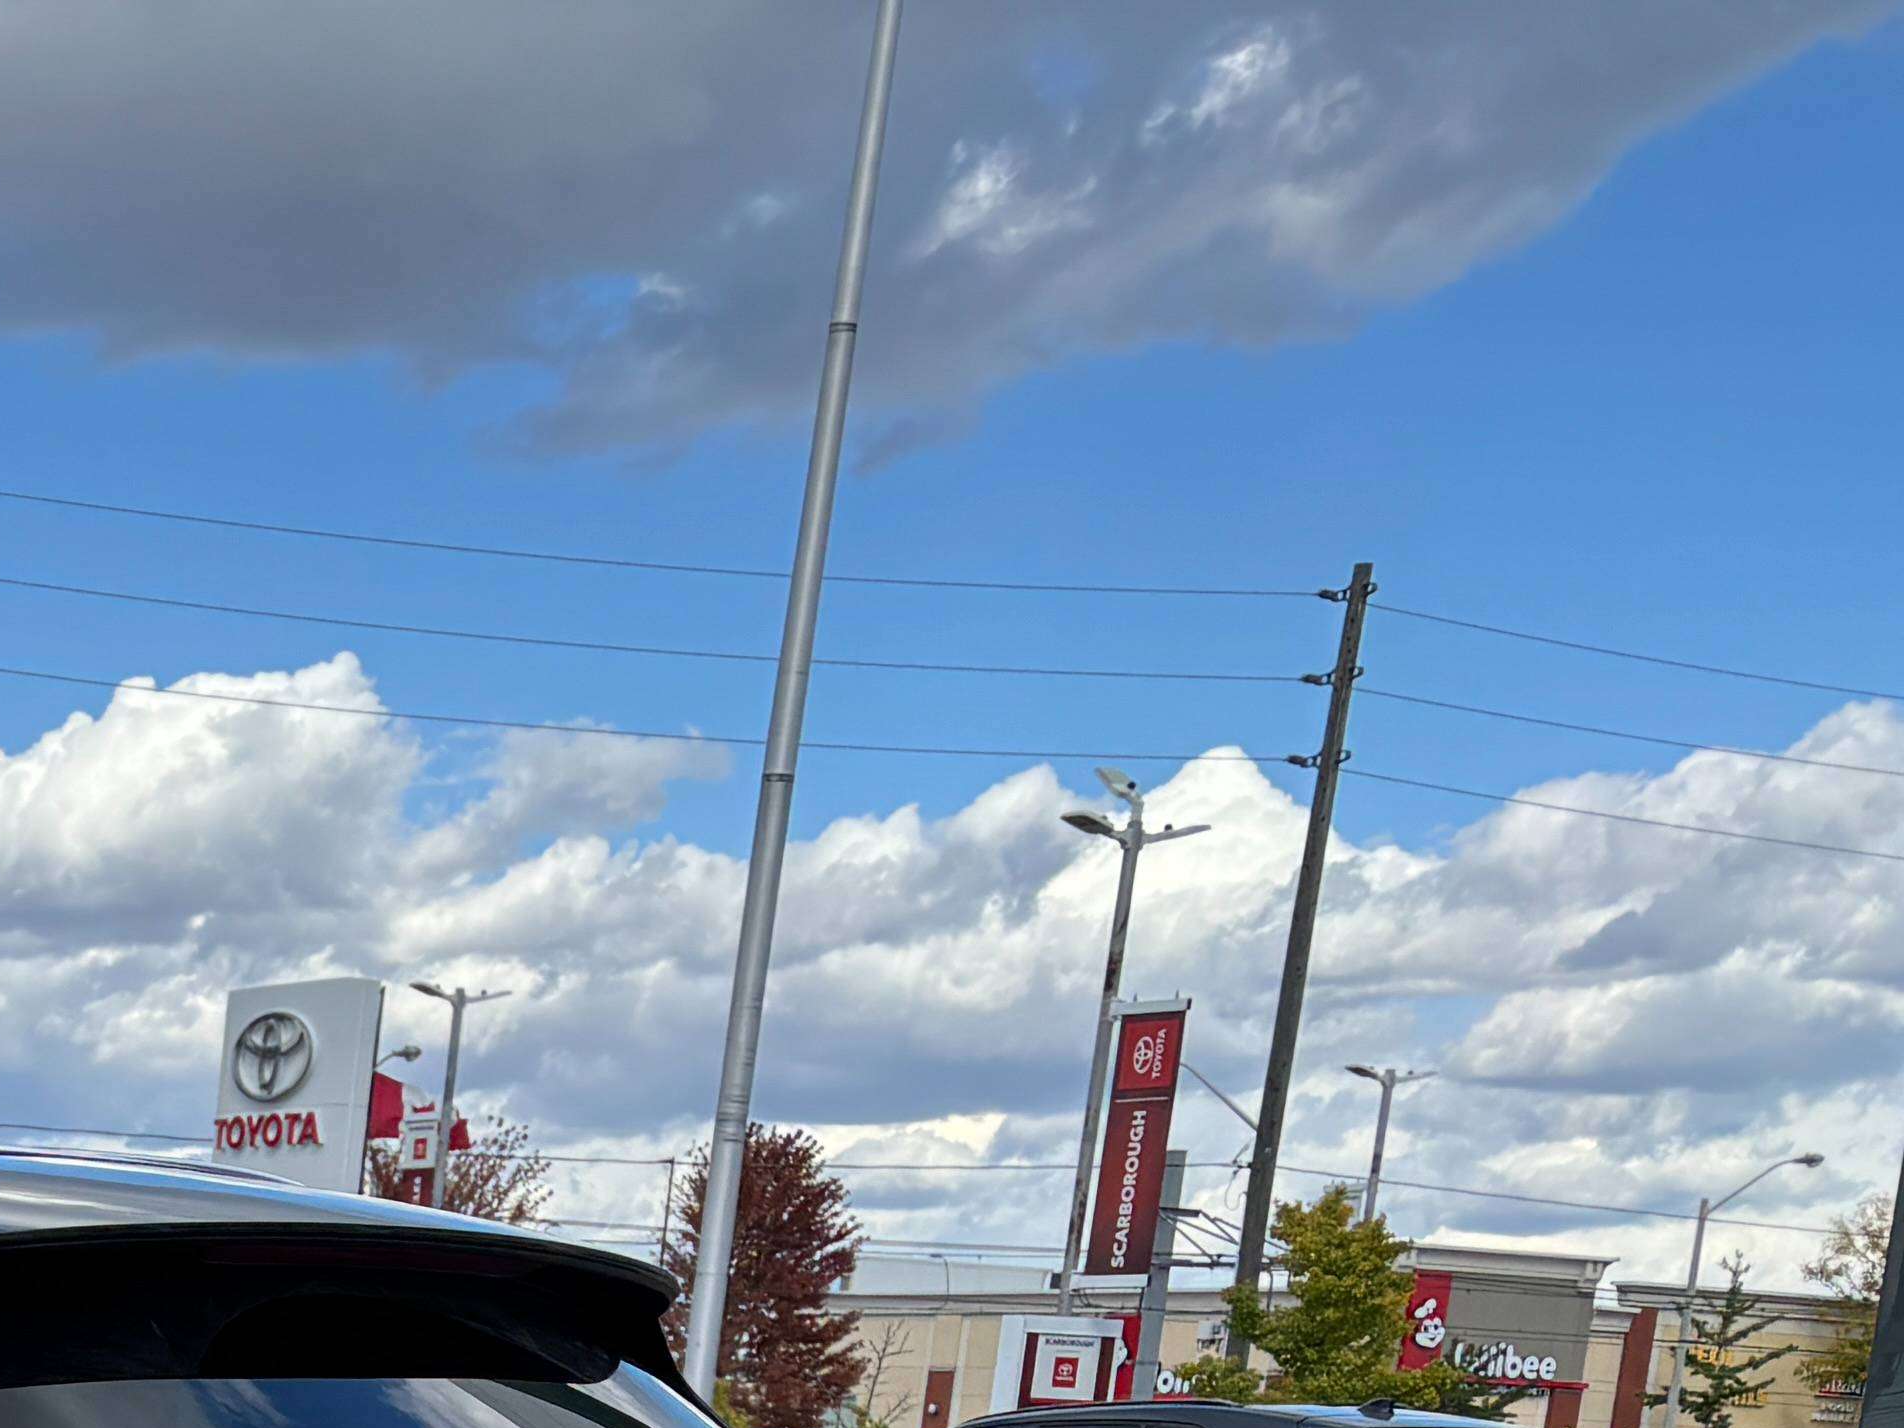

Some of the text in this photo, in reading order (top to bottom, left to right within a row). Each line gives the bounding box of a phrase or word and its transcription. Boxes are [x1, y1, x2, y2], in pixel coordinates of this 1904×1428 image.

[1151, 1029, 1168, 1080] TOYOTA
[213, 1111, 322, 1152] TOYOTA
[1110, 1109, 1148, 1269] SCARBOROUGH
